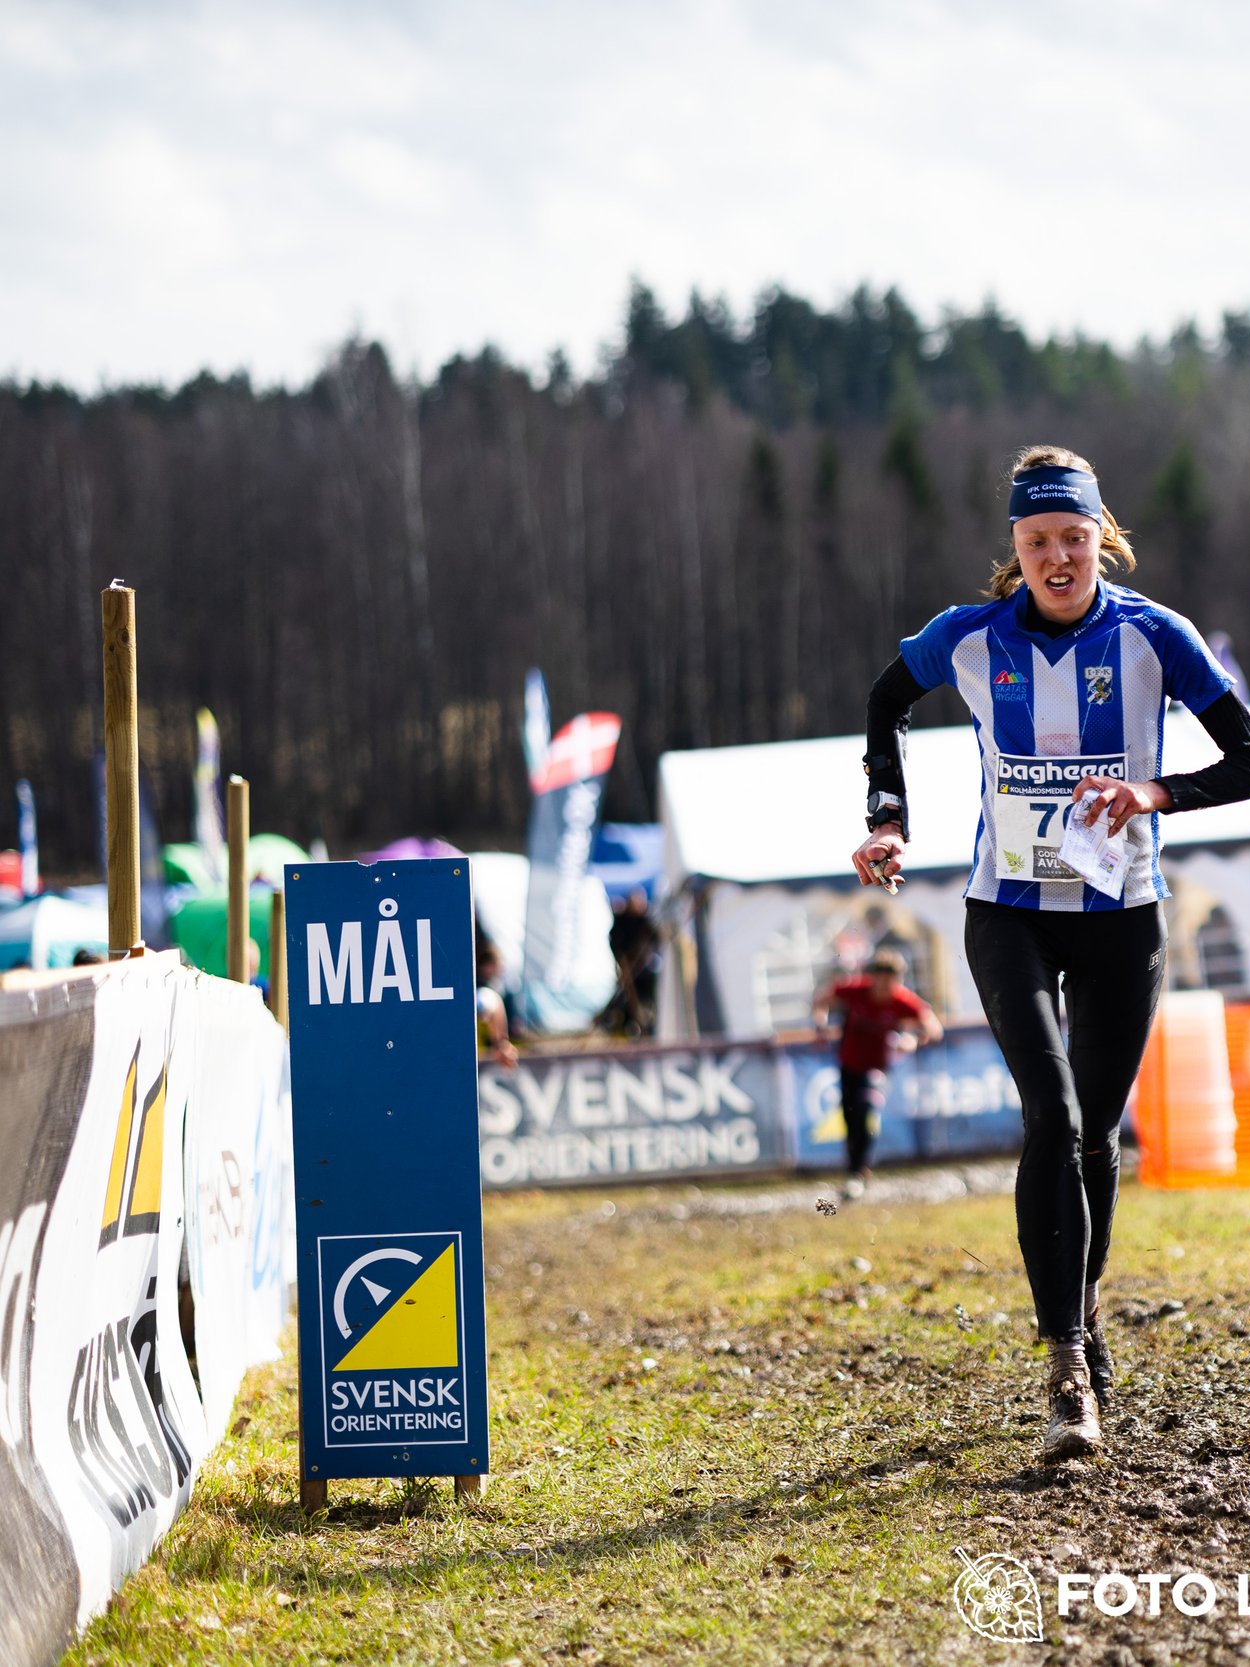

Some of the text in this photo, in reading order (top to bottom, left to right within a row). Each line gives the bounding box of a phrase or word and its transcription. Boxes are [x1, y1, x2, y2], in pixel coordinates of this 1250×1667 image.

[1030, 492, 1080, 501] Orientering
[1042, 484, 1081, 494] Göteborg
[998, 759, 1124, 784] bagheera
[306, 898, 454, 1006] MÅL
[479, 1051, 754, 1136] SVENSK
[481, 1117, 760, 1184] ORIENTERING
[331, 1378, 460, 1410] SVENSK
[331, 1411, 462, 1433] ORIENTERING
